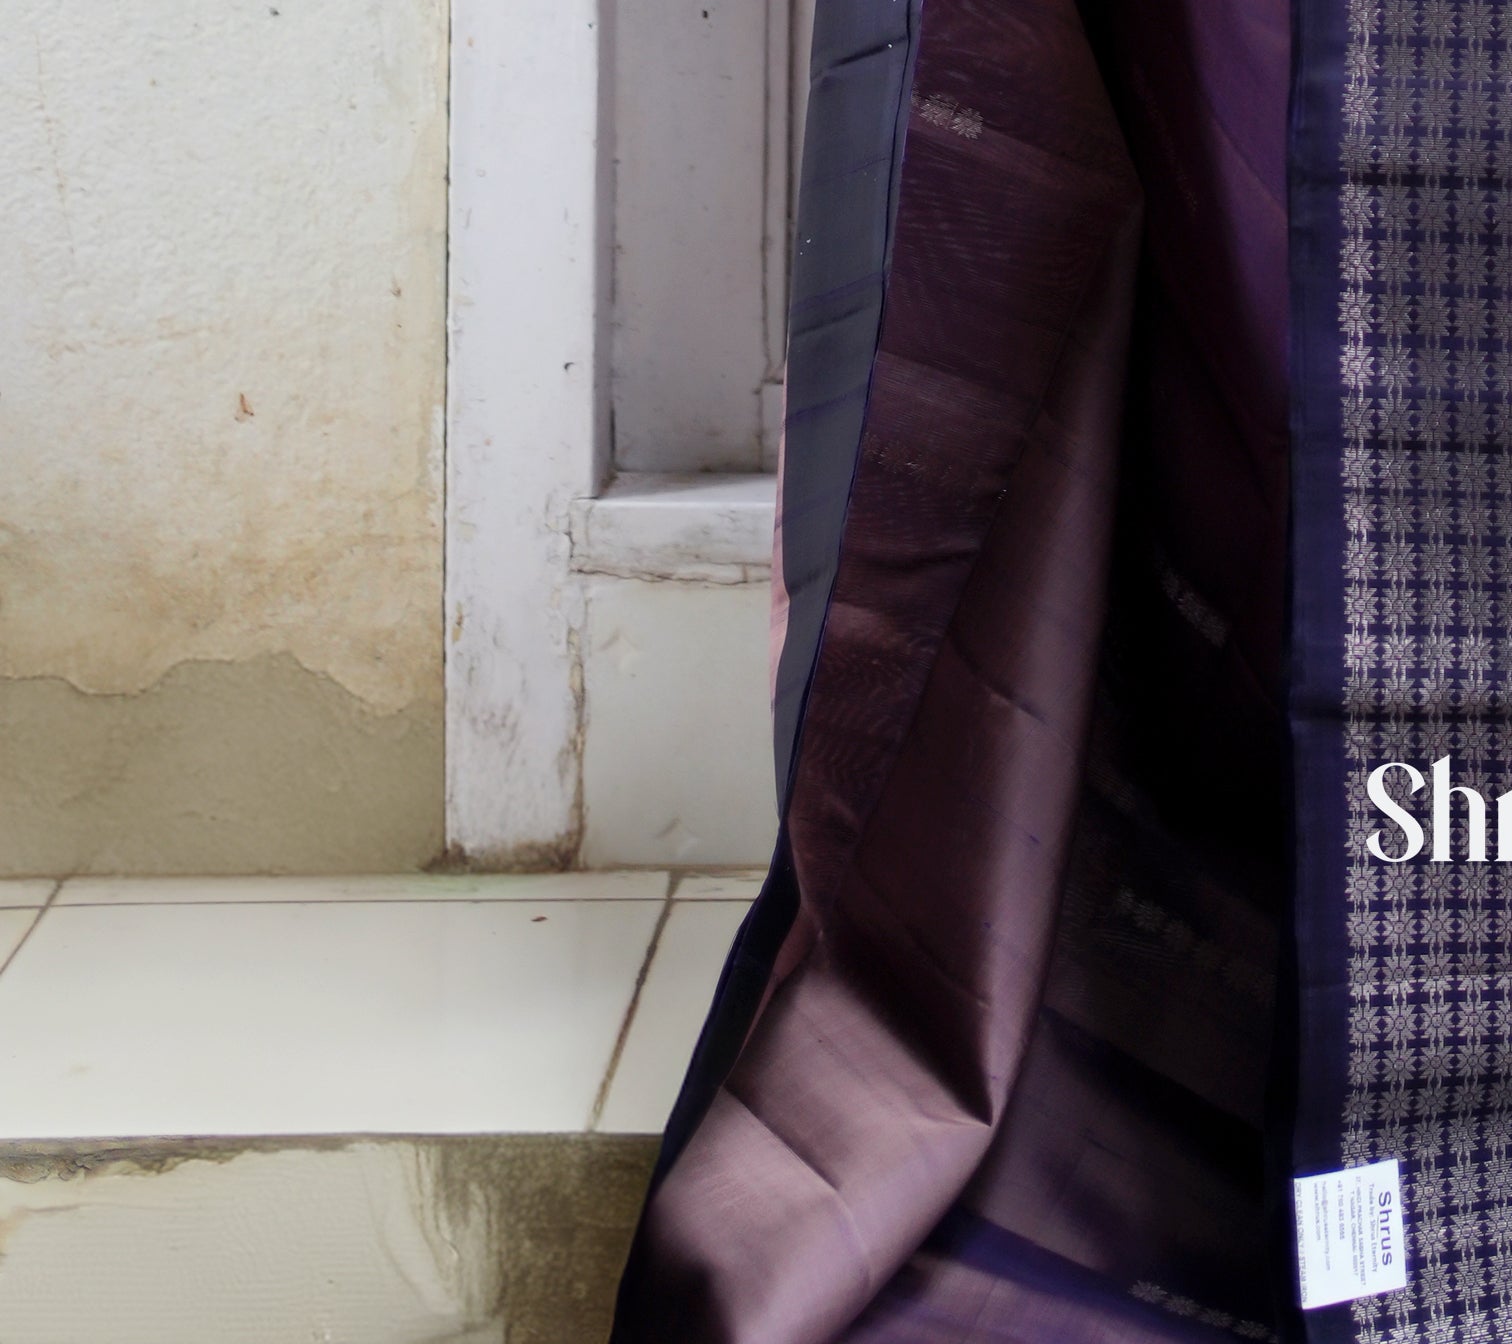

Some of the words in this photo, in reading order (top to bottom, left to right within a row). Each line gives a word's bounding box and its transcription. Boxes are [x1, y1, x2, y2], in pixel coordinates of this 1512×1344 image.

[1295, 1199, 1303, 1225] CLEAN
[1378, 1191, 1393, 1266] Shrus
[1370, 1242, 1378, 1272] Eternity
